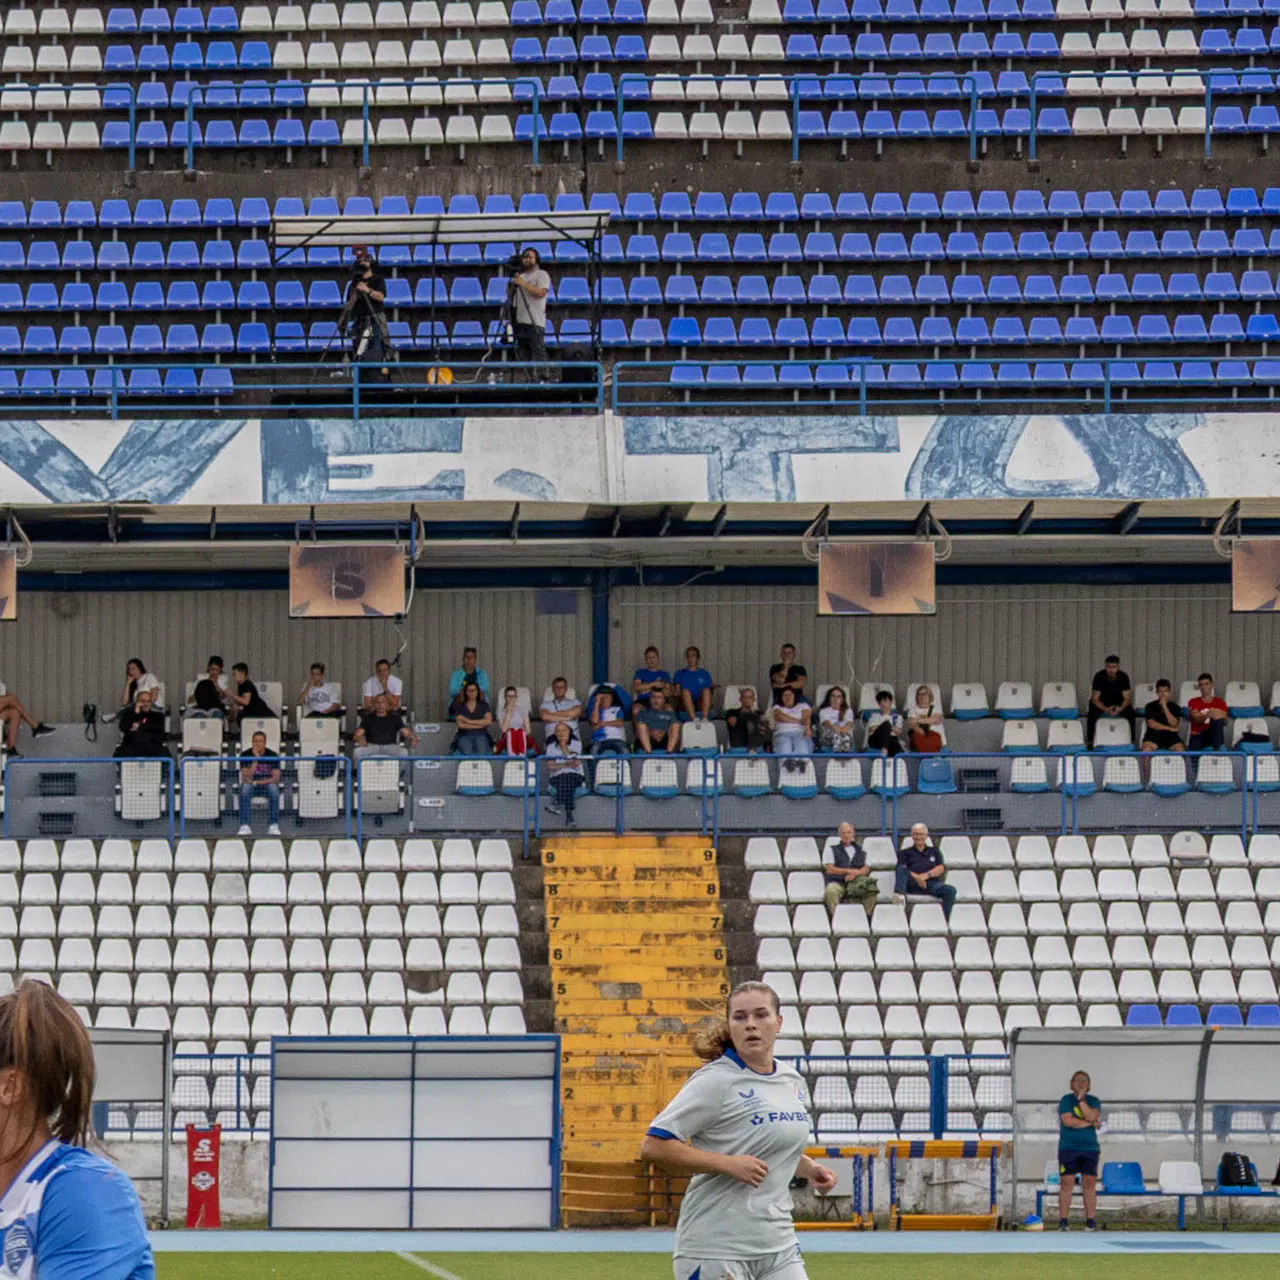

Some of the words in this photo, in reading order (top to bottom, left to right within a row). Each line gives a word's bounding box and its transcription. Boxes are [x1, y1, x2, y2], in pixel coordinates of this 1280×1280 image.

[546, 852, 555, 863] 9
[704, 850, 713, 861] 9
[548, 884, 558, 895] 8
[707, 884, 716, 894] 8
[550, 917, 560, 928] 7
[711, 917, 720, 928] 7
[554, 950, 562, 960] 6
[714, 949, 724, 960] 6
[557, 984, 566, 994] 5
[720, 984, 728, 994] 5
[564, 1088, 574, 1100] 2
